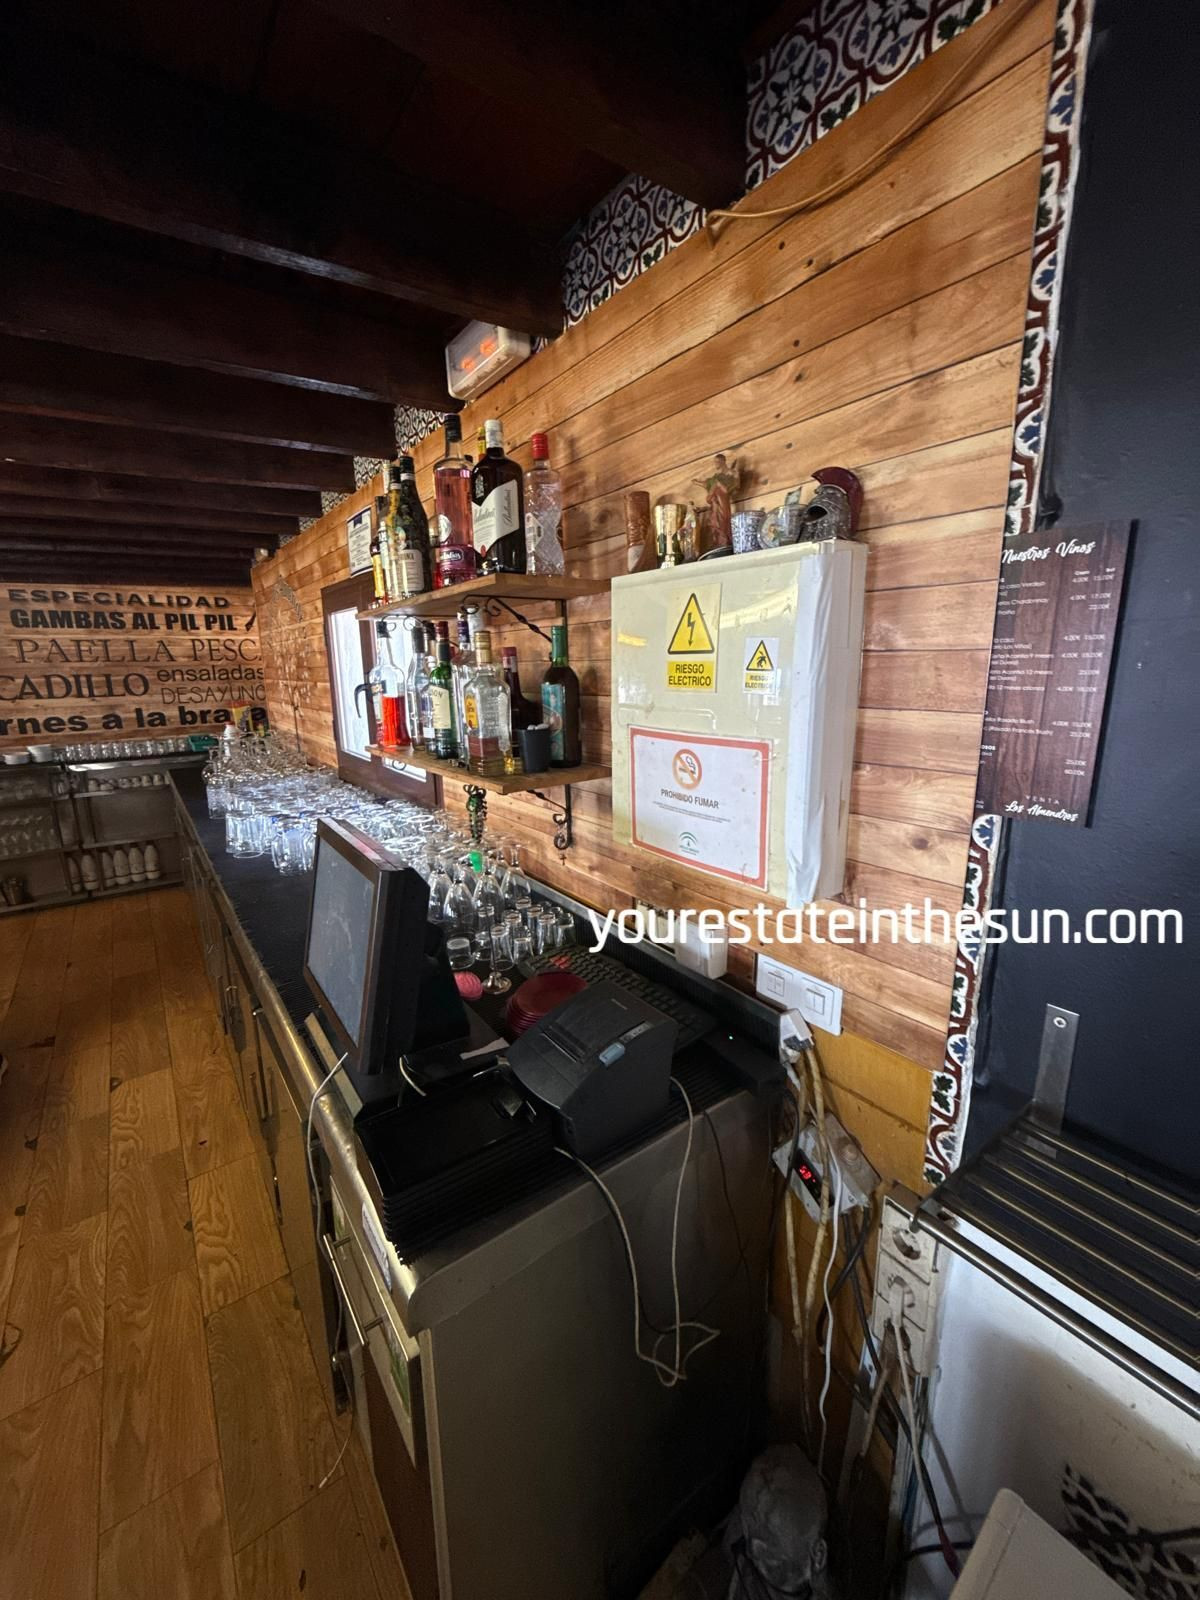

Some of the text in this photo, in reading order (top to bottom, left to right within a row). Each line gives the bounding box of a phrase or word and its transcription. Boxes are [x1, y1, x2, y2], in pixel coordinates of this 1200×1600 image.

[1055, 539, 1096, 557] Vinos
[7, 588, 230, 609] ESPECIALIDAD
[10, 608, 238, 632] GAMBAS AL PIL PIL
[14, 638, 262, 664] PAELLA PESC
[156, 664, 264, 682] ensaladas
[675, 663, 705, 674] RIESGO
[0, 672, 149, 701] CADILLO
[668, 675, 711, 687] ELECTRICO
[0, 705, 270, 735] rnes a la braa
[660, 788, 720, 809] PROHIBIDO FUMAR
[1005, 801, 1025, 813] Los
